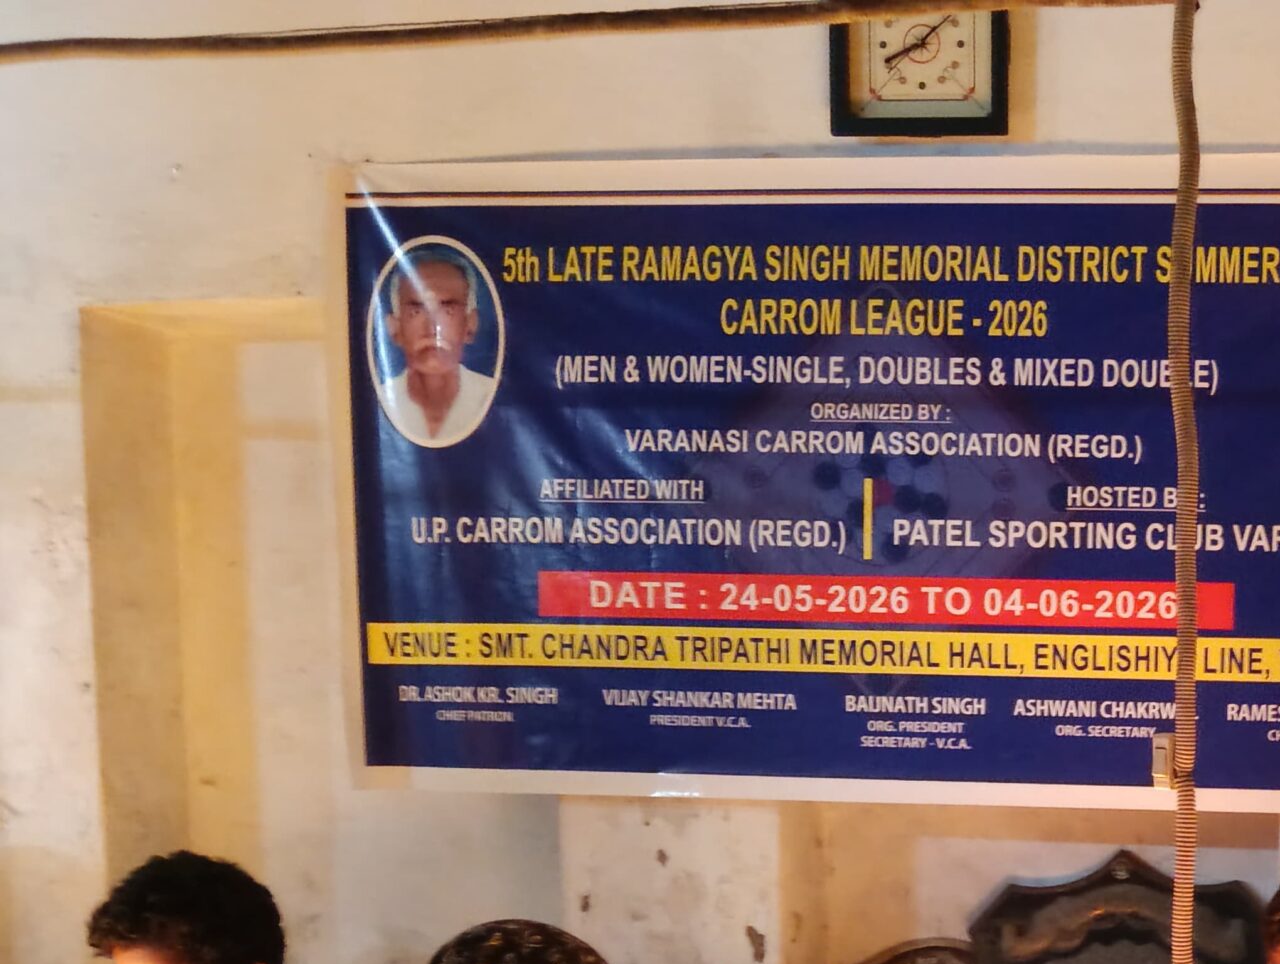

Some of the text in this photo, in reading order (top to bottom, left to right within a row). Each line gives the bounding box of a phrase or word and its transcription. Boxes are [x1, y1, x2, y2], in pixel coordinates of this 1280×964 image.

[503, 245, 1280, 284] 5th LATE RAMAGYA SINGH MEMORIAL DISTRICT SMMER
[721, 299, 841, 335] CARROM
[851, 299, 963, 336] LEAGUE
[988, 300, 1047, 336] 2026
[555, 356, 615, 389] (MEN
[624, 356, 639, 382] &
[647, 356, 850, 388] WOMEN-SINGLE,
[859, 357, 981, 385] DOUBLES
[989, 358, 1006, 385] &
[1014, 358, 1094, 386] MIXED
[811, 404, 913, 420] ORGANIZED
[917, 405, 943, 421] BY
[625, 429, 1142, 464] VARANASI CARROM ASSOCIATION (REGD.)
[540, 478, 704, 500] AFFILIATED WITH
[1067, 486, 1156, 507] HOSTED
[1164, 488, 1178, 508] B
[411, 517, 845, 554] U.P. CARROM ASSOCIATION (REGD.)
[894, 519, 981, 546] PATEL
[989, 520, 1136, 549] SPORTING
[590, 580, 686, 609] DATE
[720, 583, 909, 613] 24-05-2026
[921, 587, 971, 615] TO
[984, 589, 1178, 618] 04-06-2026
[384, 632, 457, 657] VENUE
[480, 633, 532, 658] SMT.
[542, 634, 668, 661] CHANDRA
[675, 636, 789, 663] TRIPATHI
[800, 639, 939, 667] MEMORIAL
[950, 642, 1023, 674] HALL,
[1035, 643, 1178, 672] ENGLISHIY
[1205, 648, 1269, 678] LINE,
[424, 686, 476, 702] ASHOK
[506, 687, 558, 704] SINGH
[602, 689, 797, 710] VIJAY SHANKAR MEHTA
[846, 695, 986, 714] BAIJNATH SINGH
[436, 710, 465, 721] CHIEF
[1014, 699, 1096, 717] ASHWANI
[650, 715, 751, 728] PRESIDENT V.C.A.
[867, 720, 964, 733] ORG. PRESIDENT
[1055, 725, 1156, 738] ORG. SECRETARY
[861, 736, 927, 748] SECRETARY
[936, 738, 971, 749] V.C.A.
